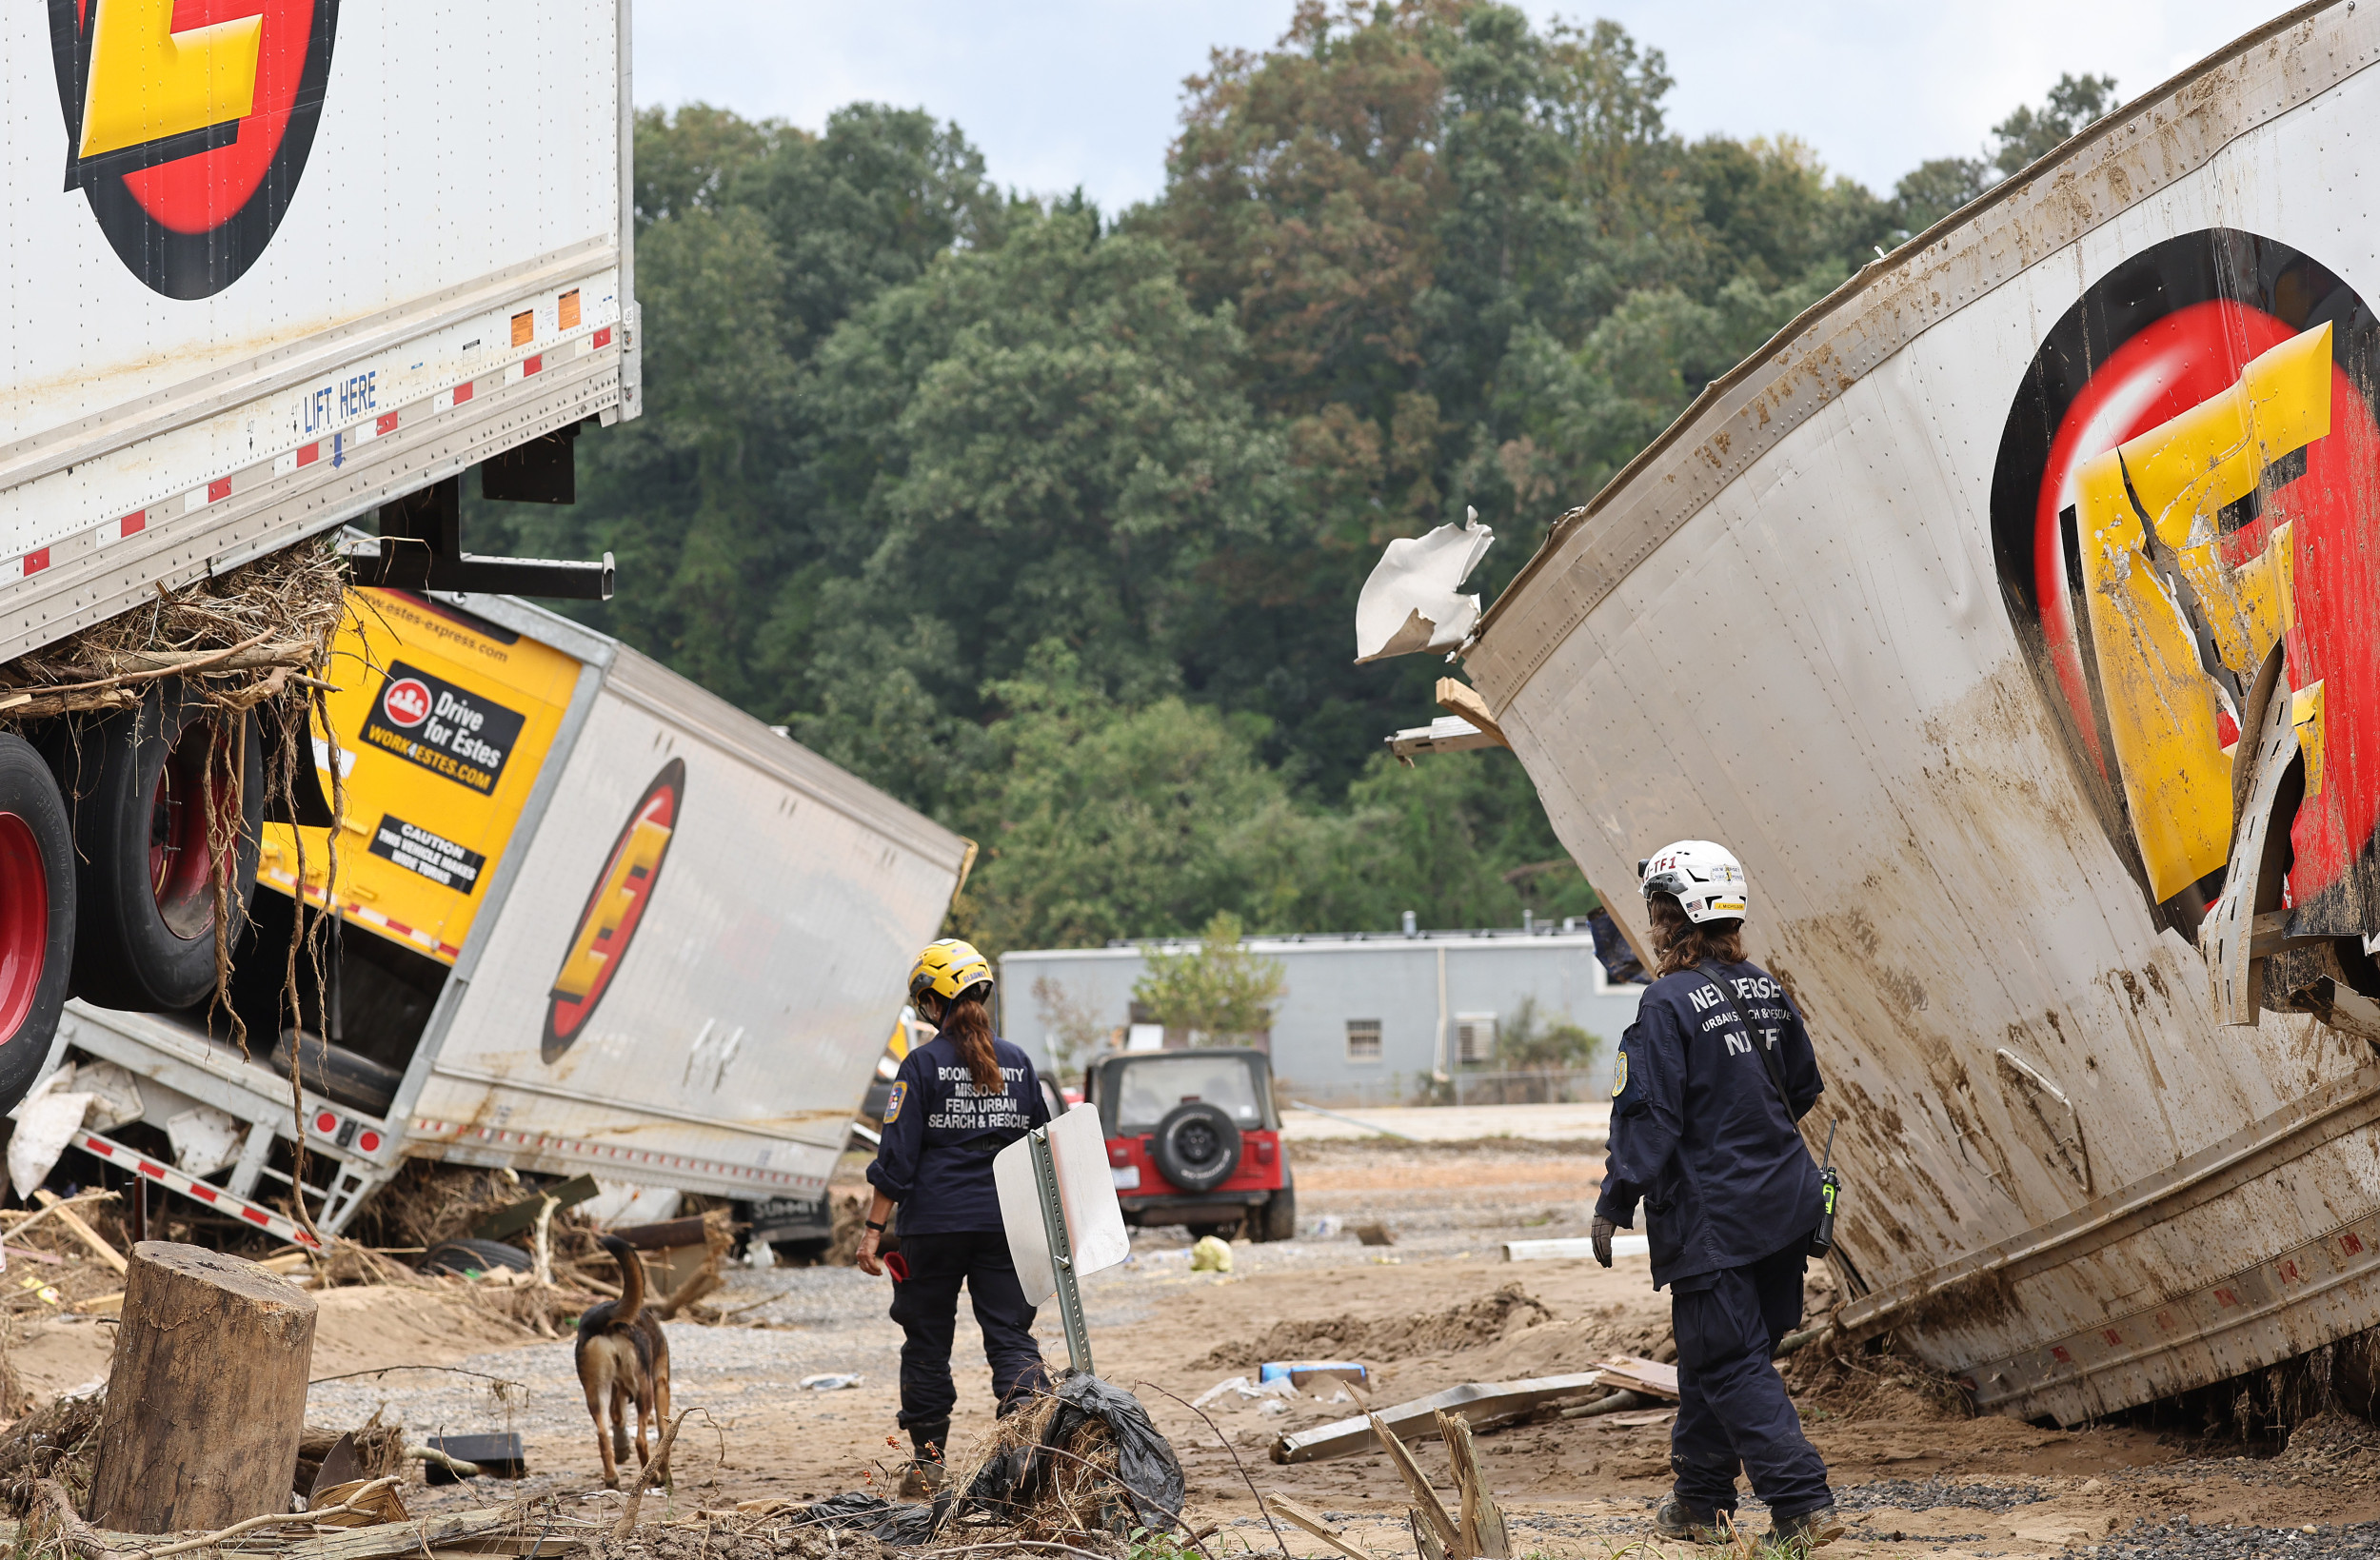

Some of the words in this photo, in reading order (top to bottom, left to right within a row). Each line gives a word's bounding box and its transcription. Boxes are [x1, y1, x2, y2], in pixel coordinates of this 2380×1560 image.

[304, 386, 332, 434] LIFT
[340, 370, 376, 419] HERE
[434, 691, 485, 732] Drive
[367, 723, 493, 791] WORK4ESTES.COM
[423, 716, 453, 747] for
[450, 729, 503, 769] Estes
[378, 827, 403, 848] THIS
[401, 838, 443, 866] VEHICLE
[440, 856, 478, 881] MAKES
[401, 823, 466, 860] CAUTION
[391, 848, 420, 872] WIDE
[417, 860, 452, 885] TURNS
[1642, 856, 1676, 883] J-TF1
[1730, 977, 1781, 999] JERSE
[928, 1114, 976, 1129] SEARCH
[978, 1115, 986, 1128] &
[988, 1113, 1030, 1130] RESCUE
[945, 1098, 976, 1114] FEMA
[978, 1097, 1018, 1114] URBAN
